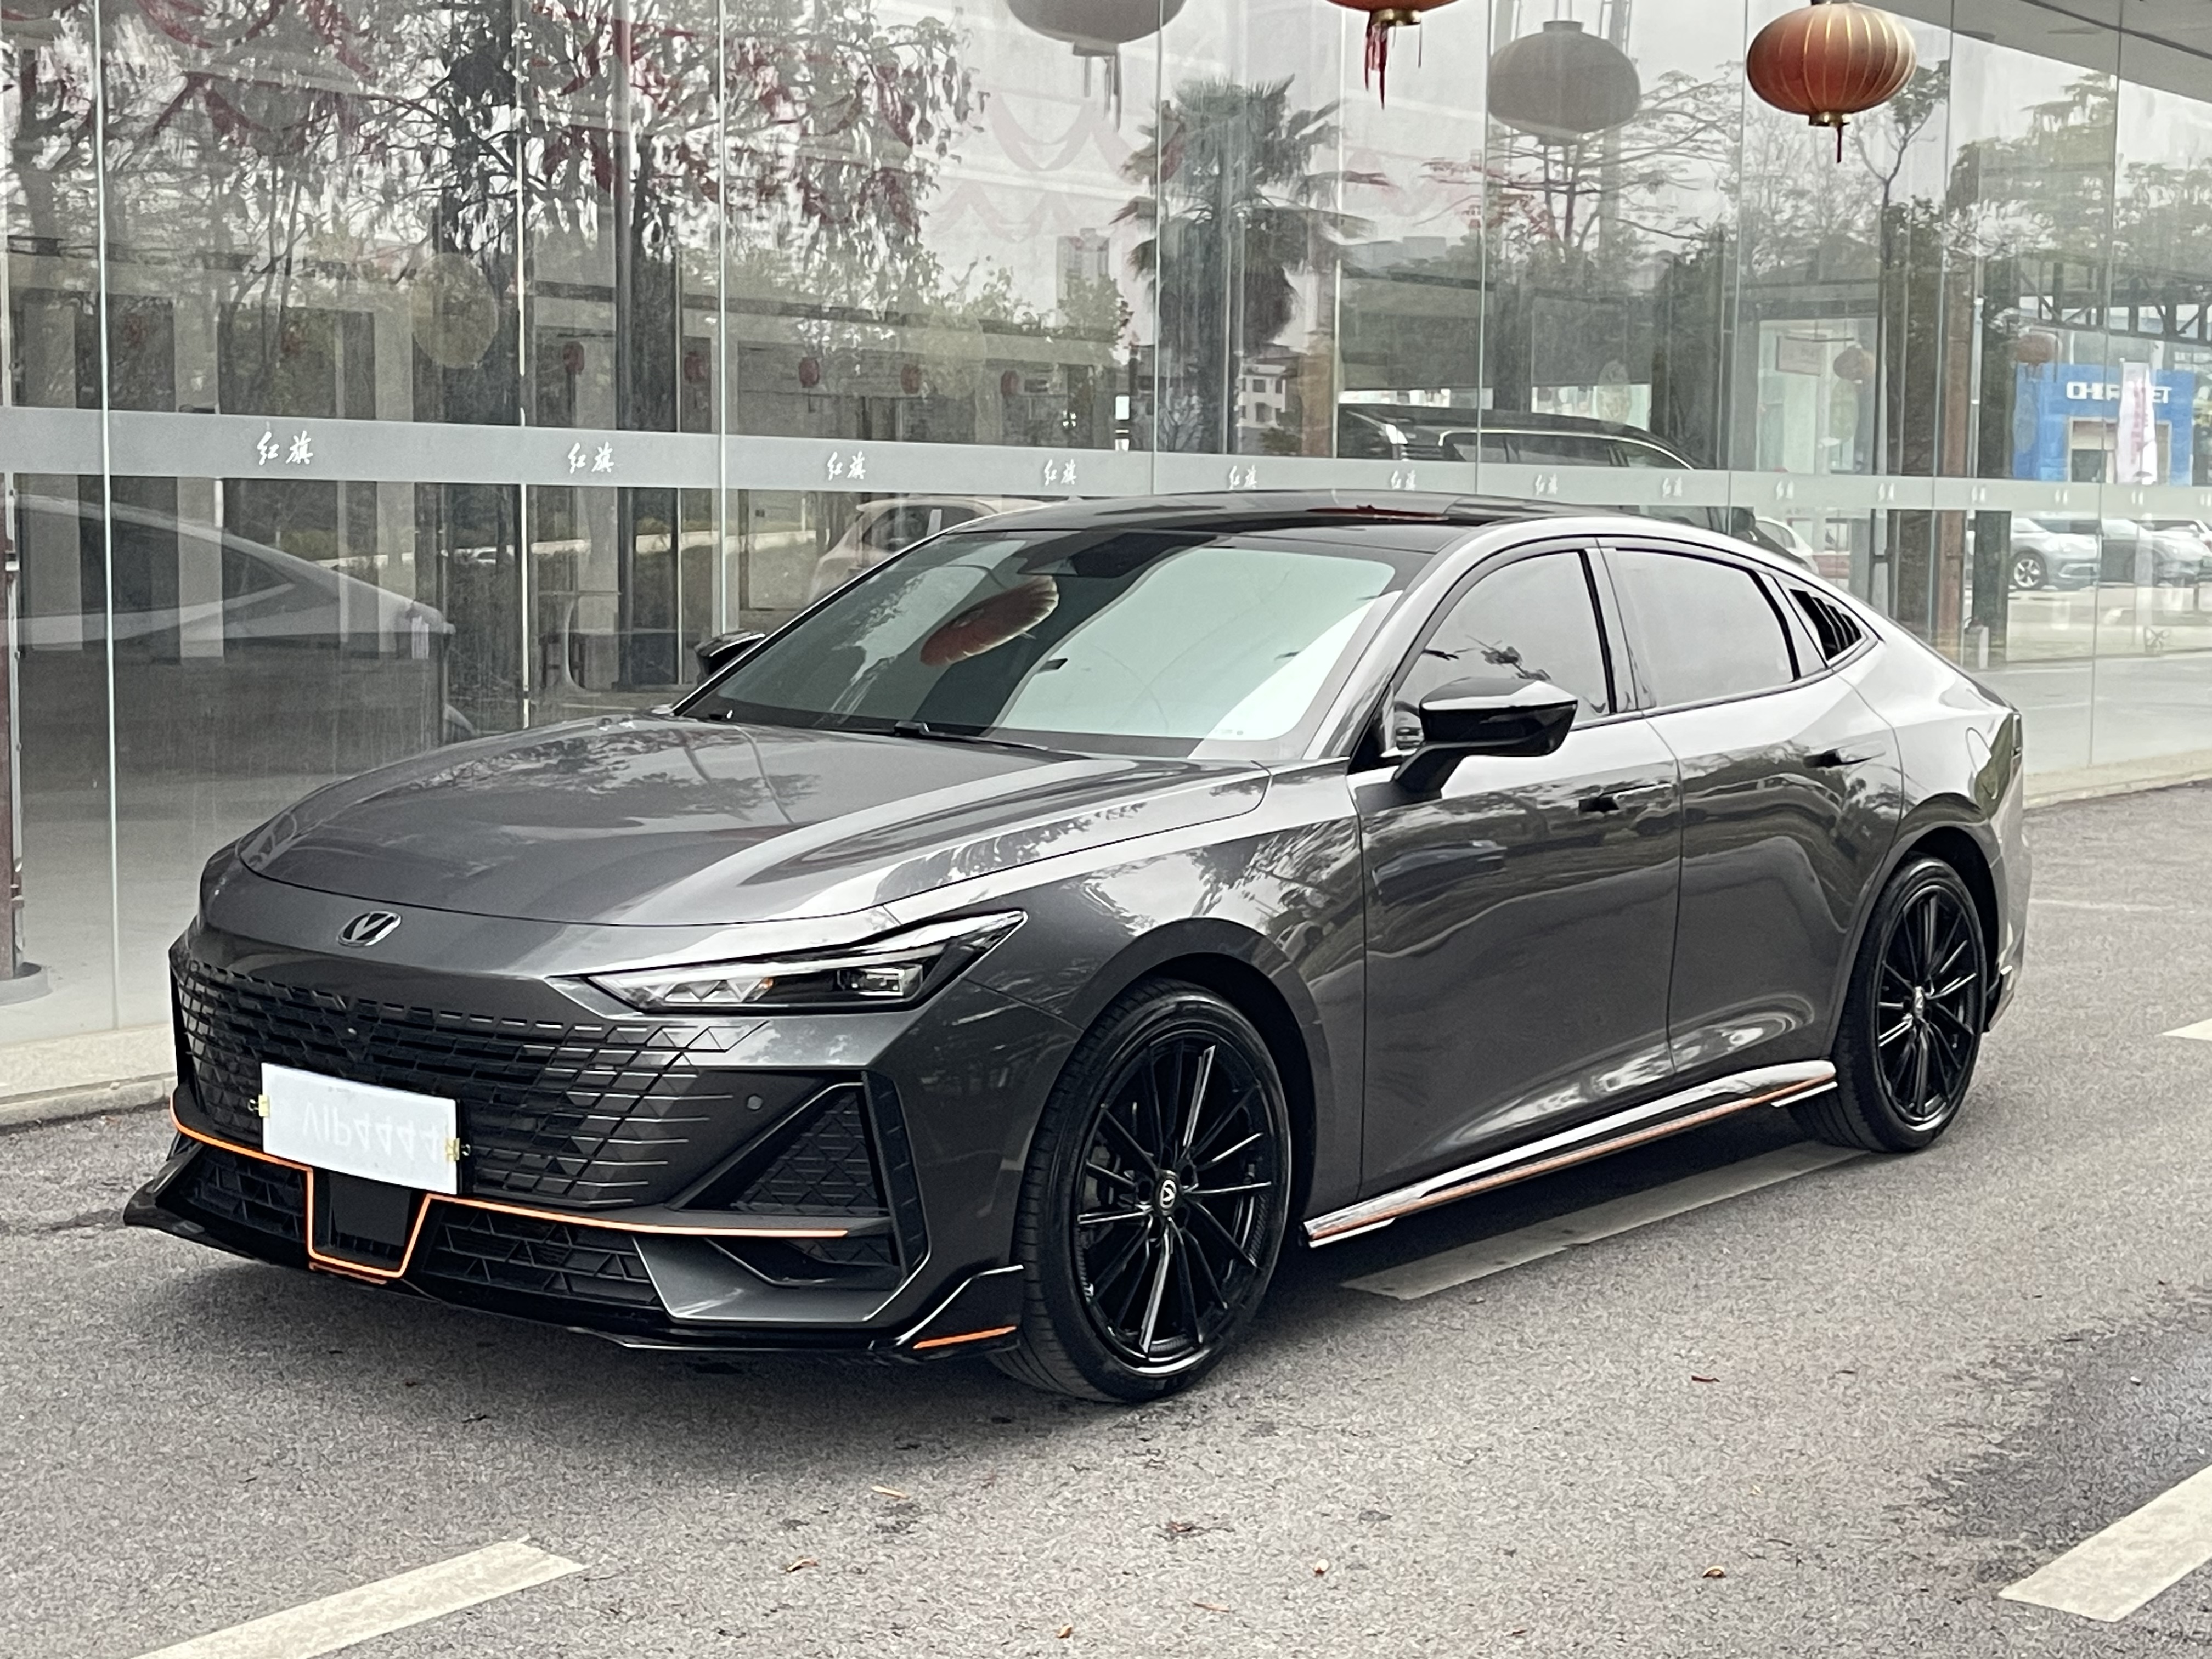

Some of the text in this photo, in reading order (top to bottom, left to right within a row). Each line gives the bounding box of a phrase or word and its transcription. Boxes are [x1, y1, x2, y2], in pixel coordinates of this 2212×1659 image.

[257, 431, 314, 466] 红旗
[568, 441, 614, 474] 红旗
[827, 450, 866, 481] 红旗
[1044, 459, 1077, 486] 红旗
